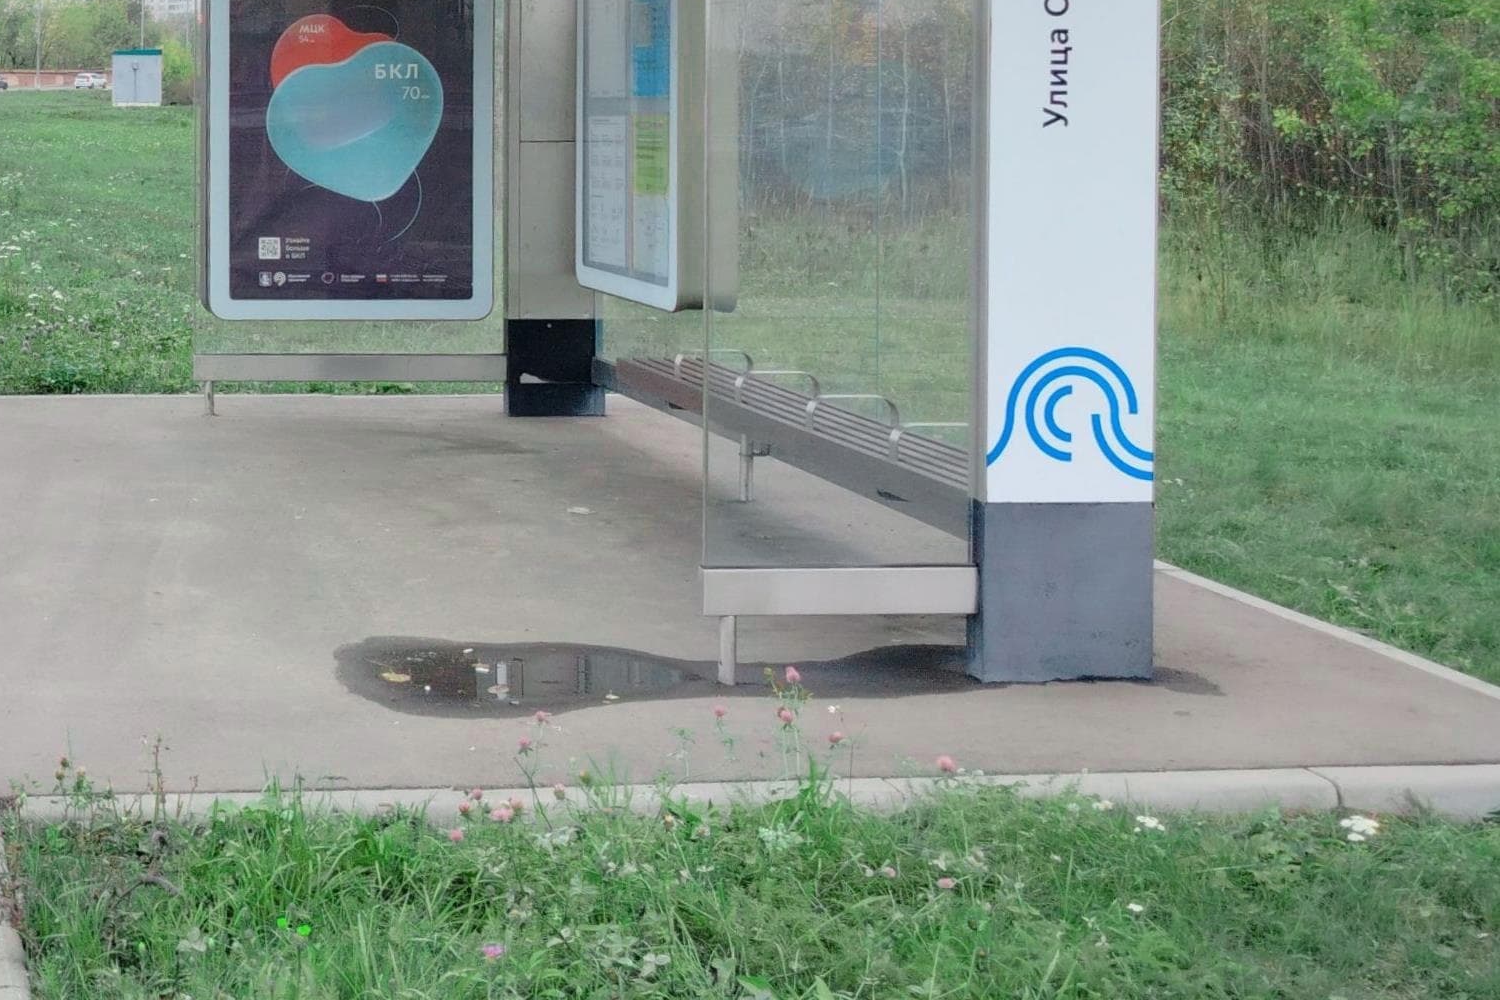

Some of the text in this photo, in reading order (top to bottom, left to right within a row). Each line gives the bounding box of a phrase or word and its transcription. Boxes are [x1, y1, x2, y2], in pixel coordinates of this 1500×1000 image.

[299, 24, 325, 35] МЦК
[374, 63, 419, 80] БКЛ
[1042, 28, 1073, 128] Улица
[401, 86, 420, 100] 70
